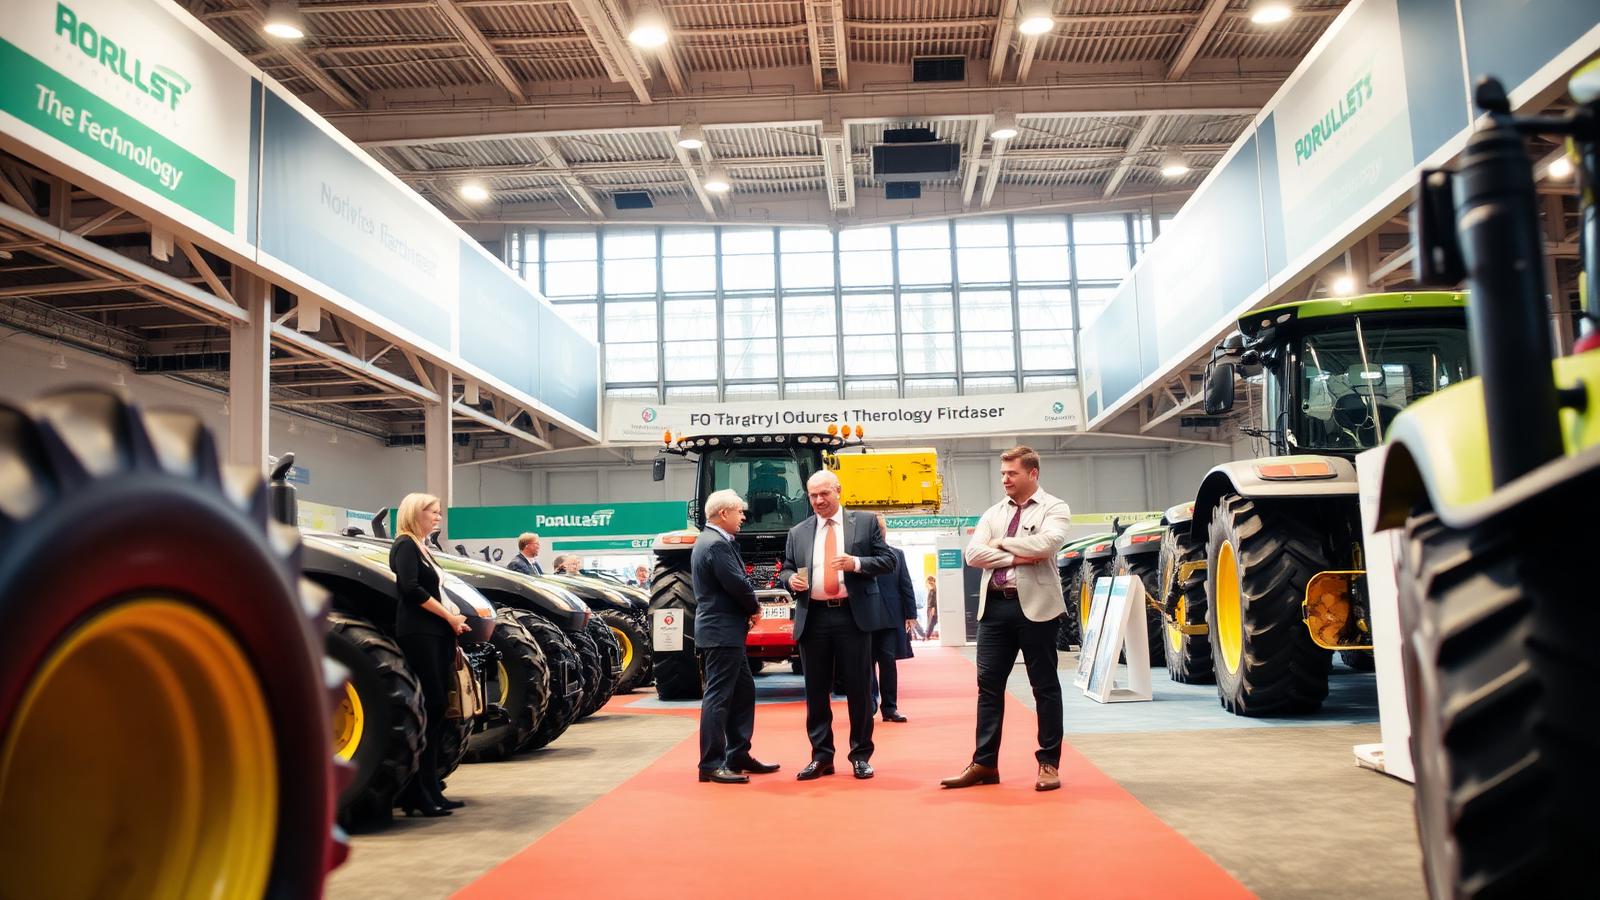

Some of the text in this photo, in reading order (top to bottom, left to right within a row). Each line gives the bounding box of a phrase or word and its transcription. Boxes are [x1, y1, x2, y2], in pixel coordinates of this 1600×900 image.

[36, 84, 75, 127] The
[78, 109, 184, 191] Fechnology
[852, 408, 933, 424] Therology
